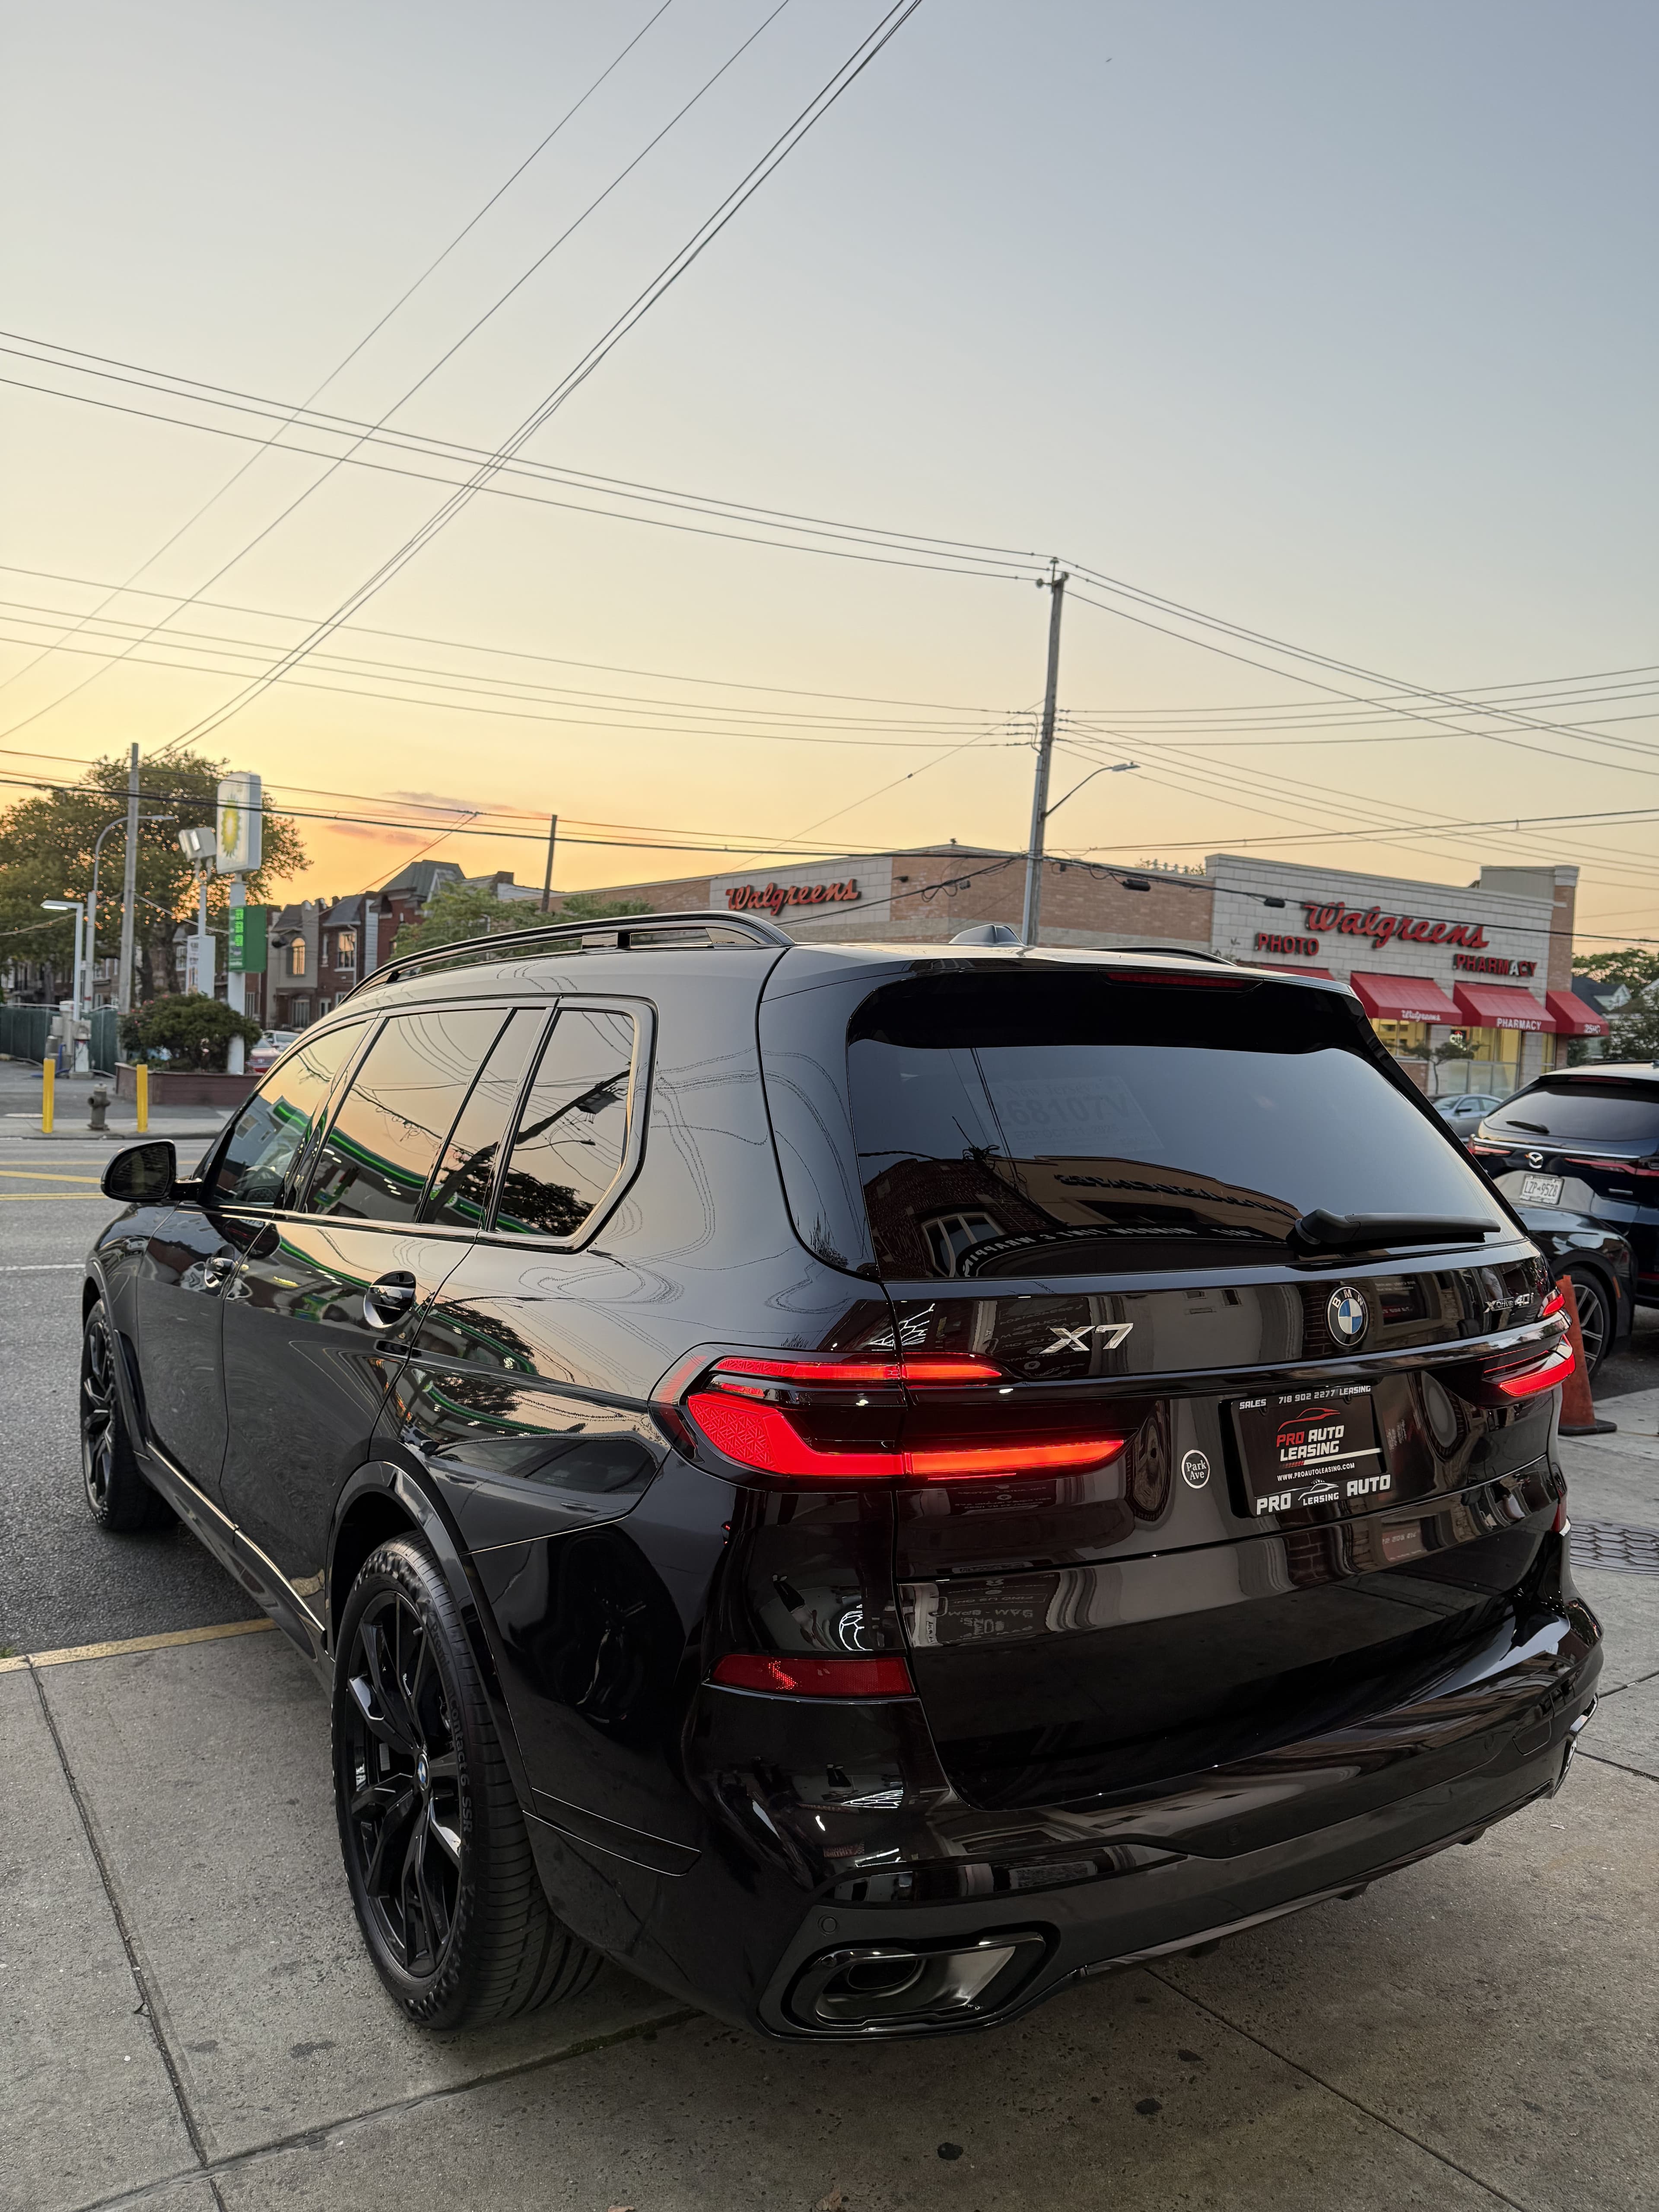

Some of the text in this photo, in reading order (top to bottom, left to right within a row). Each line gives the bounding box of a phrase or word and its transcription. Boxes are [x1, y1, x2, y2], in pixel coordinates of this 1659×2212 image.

[726, 879, 859, 915] Walgreens
[1303, 902, 1489, 949] Walgreens
[1258, 933, 1319, 956] PHOTO
[1456, 953, 1538, 977] PHARMACY
[1401, 1010, 1441, 1022] Walgreens
[1497, 1017, 1541, 1030] PHARMACY
[1332, 1289, 1363, 1309] BMW
[1039, 1323, 1134, 1354] X7
[1239, 1385, 1371, 1410] SALES 718 902 2277 LEASING
[1276, 1425, 1344, 1448] PRO AUTO
[1280, 1440, 1340, 1462] LEASING
[1185, 1459, 1207, 1472] Park
[1190, 1471, 1205, 1480] Ave
[1277, 1462, 1355, 1481] WWW.PROAUTOLEASING.COM
[1256, 1474, 1391, 1515] PRO LEASING AUTO
[462, 1796, 473, 1833] SSR
